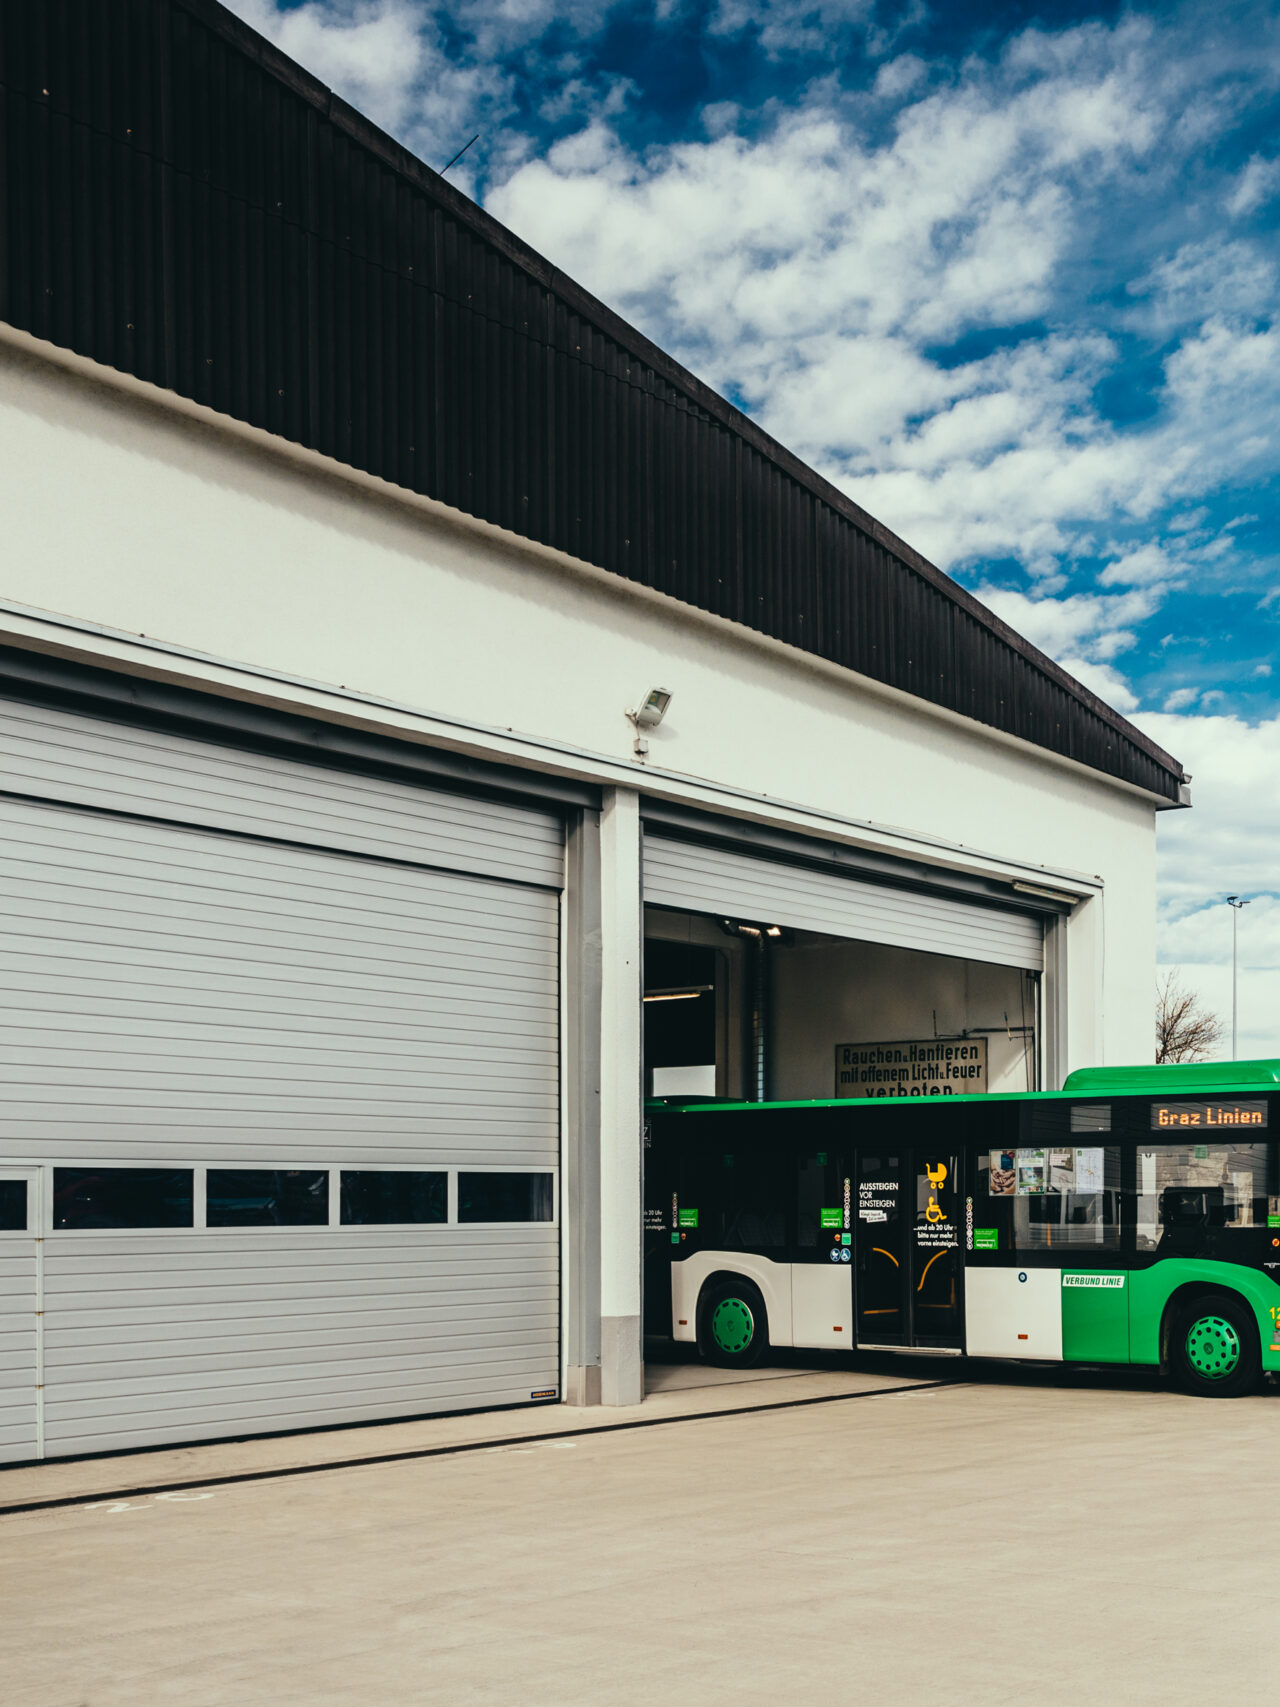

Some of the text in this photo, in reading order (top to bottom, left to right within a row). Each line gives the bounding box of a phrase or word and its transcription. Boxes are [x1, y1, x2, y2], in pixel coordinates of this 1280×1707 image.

[843, 1046, 902, 1065] Rauchen
[909, 1043, 979, 1063] Hantieren
[840, 1067, 858, 1083] mit
[860, 1065, 909, 1083] offenem
[912, 1062, 939, 1081] Licht
[946, 1062, 982, 1080] Feuer
[1158, 1107, 1263, 1126] Graz Linien
[859, 1182, 899, 1191] AUSSTEIGEN
[859, 1191, 873, 1199] VOR
[859, 1200, 895, 1208] EINSTEIGEN
[1065, 1276, 1122, 1286] VERBUND LINIE
